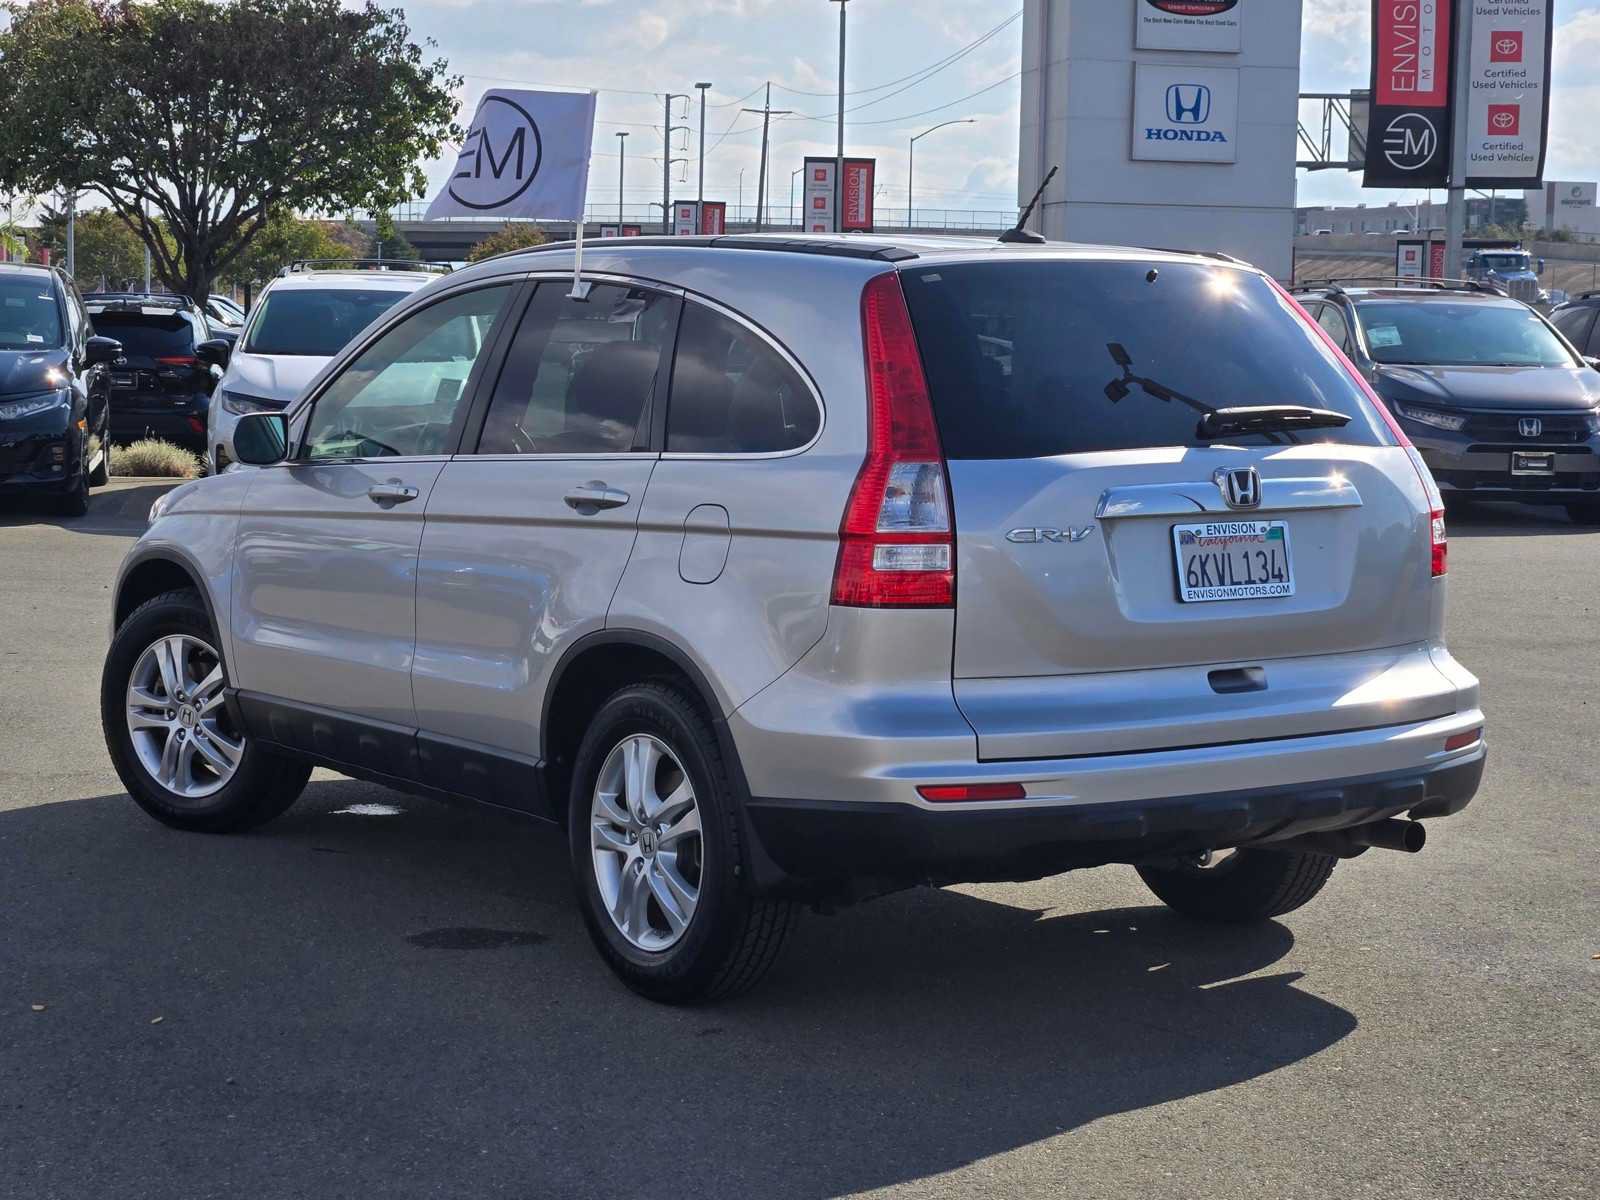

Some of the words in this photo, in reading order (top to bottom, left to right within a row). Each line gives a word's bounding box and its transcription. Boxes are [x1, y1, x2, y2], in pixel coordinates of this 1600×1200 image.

[1476, 7, 1499, 15] Used
[1502, 7, 1541, 15] Vehicles
[1484, 69, 1527, 78] Certified
[1472, 80, 1496, 89] Used
[1499, 80, 1538, 89] Vehicles
[1145, 128, 1228, 143] HONDA
[1482, 142, 1524, 151] Certified
[1470, 152, 1495, 161] Used
[1498, 153, 1535, 162] Vehicles
[848, 167, 859, 223] ENVISION
[1005, 525, 1096, 544] CR-V
[1206, 523, 1257, 536] ENVISION
[1186, 549, 1285, 588] 6KVL134
[1187, 584, 1291, 600] ENVISIONMOTORS.COM
